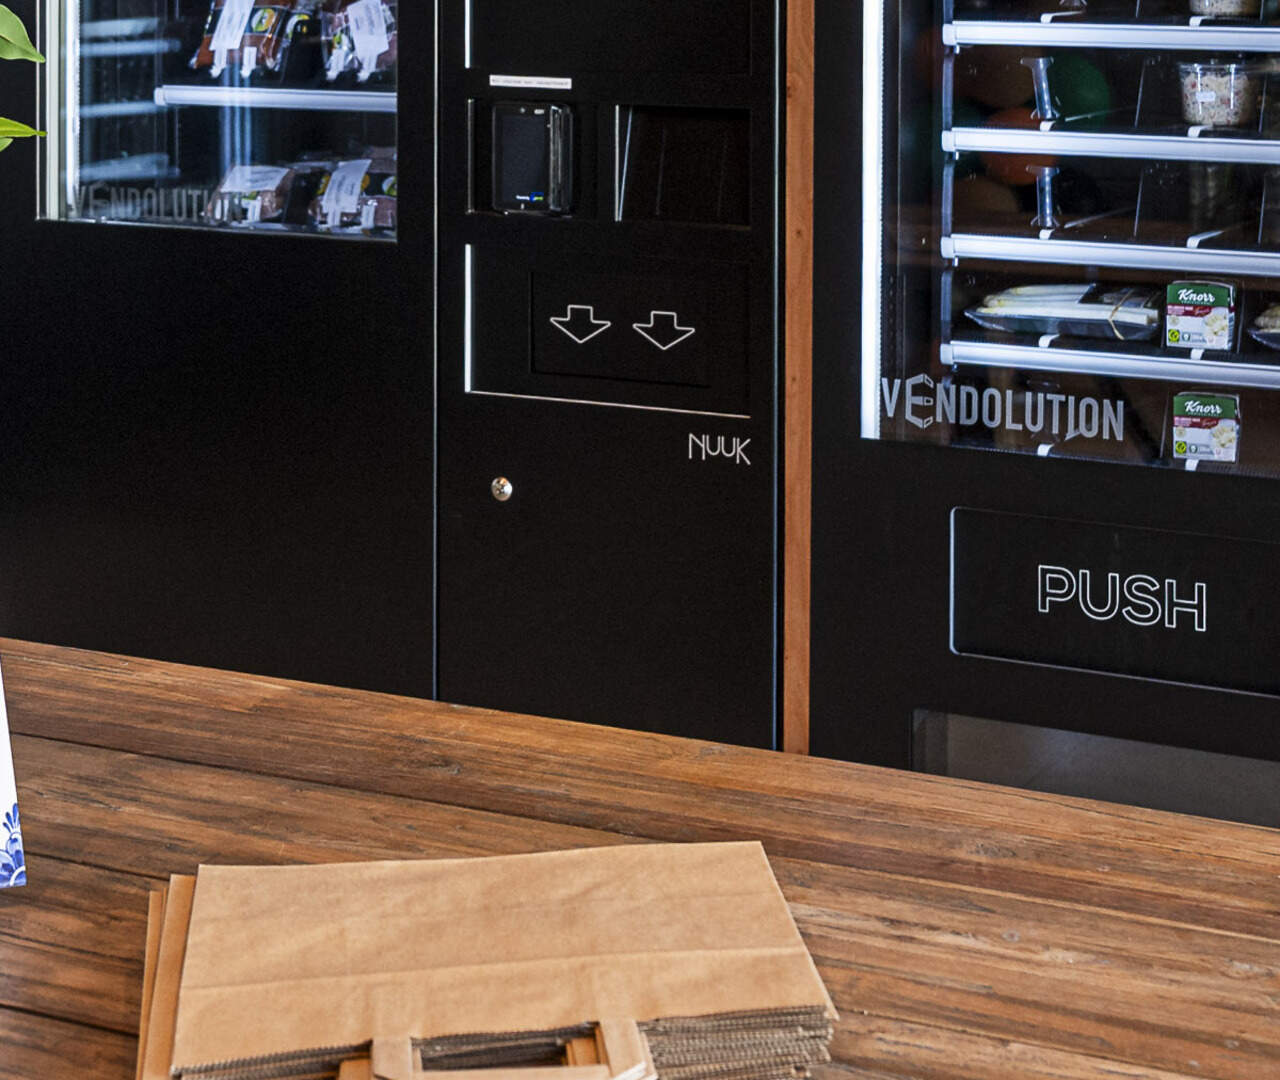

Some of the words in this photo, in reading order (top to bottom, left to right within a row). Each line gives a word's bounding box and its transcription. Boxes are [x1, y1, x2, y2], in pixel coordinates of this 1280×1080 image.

[1177, 288, 1216, 303] Knorr
[880, 373, 1125, 441] VENDOLUTION
[1184, 400, 1223, 415] Knorr
[688, 433, 752, 465] NUUK
[1036, 565, 1208, 633] PUSH
